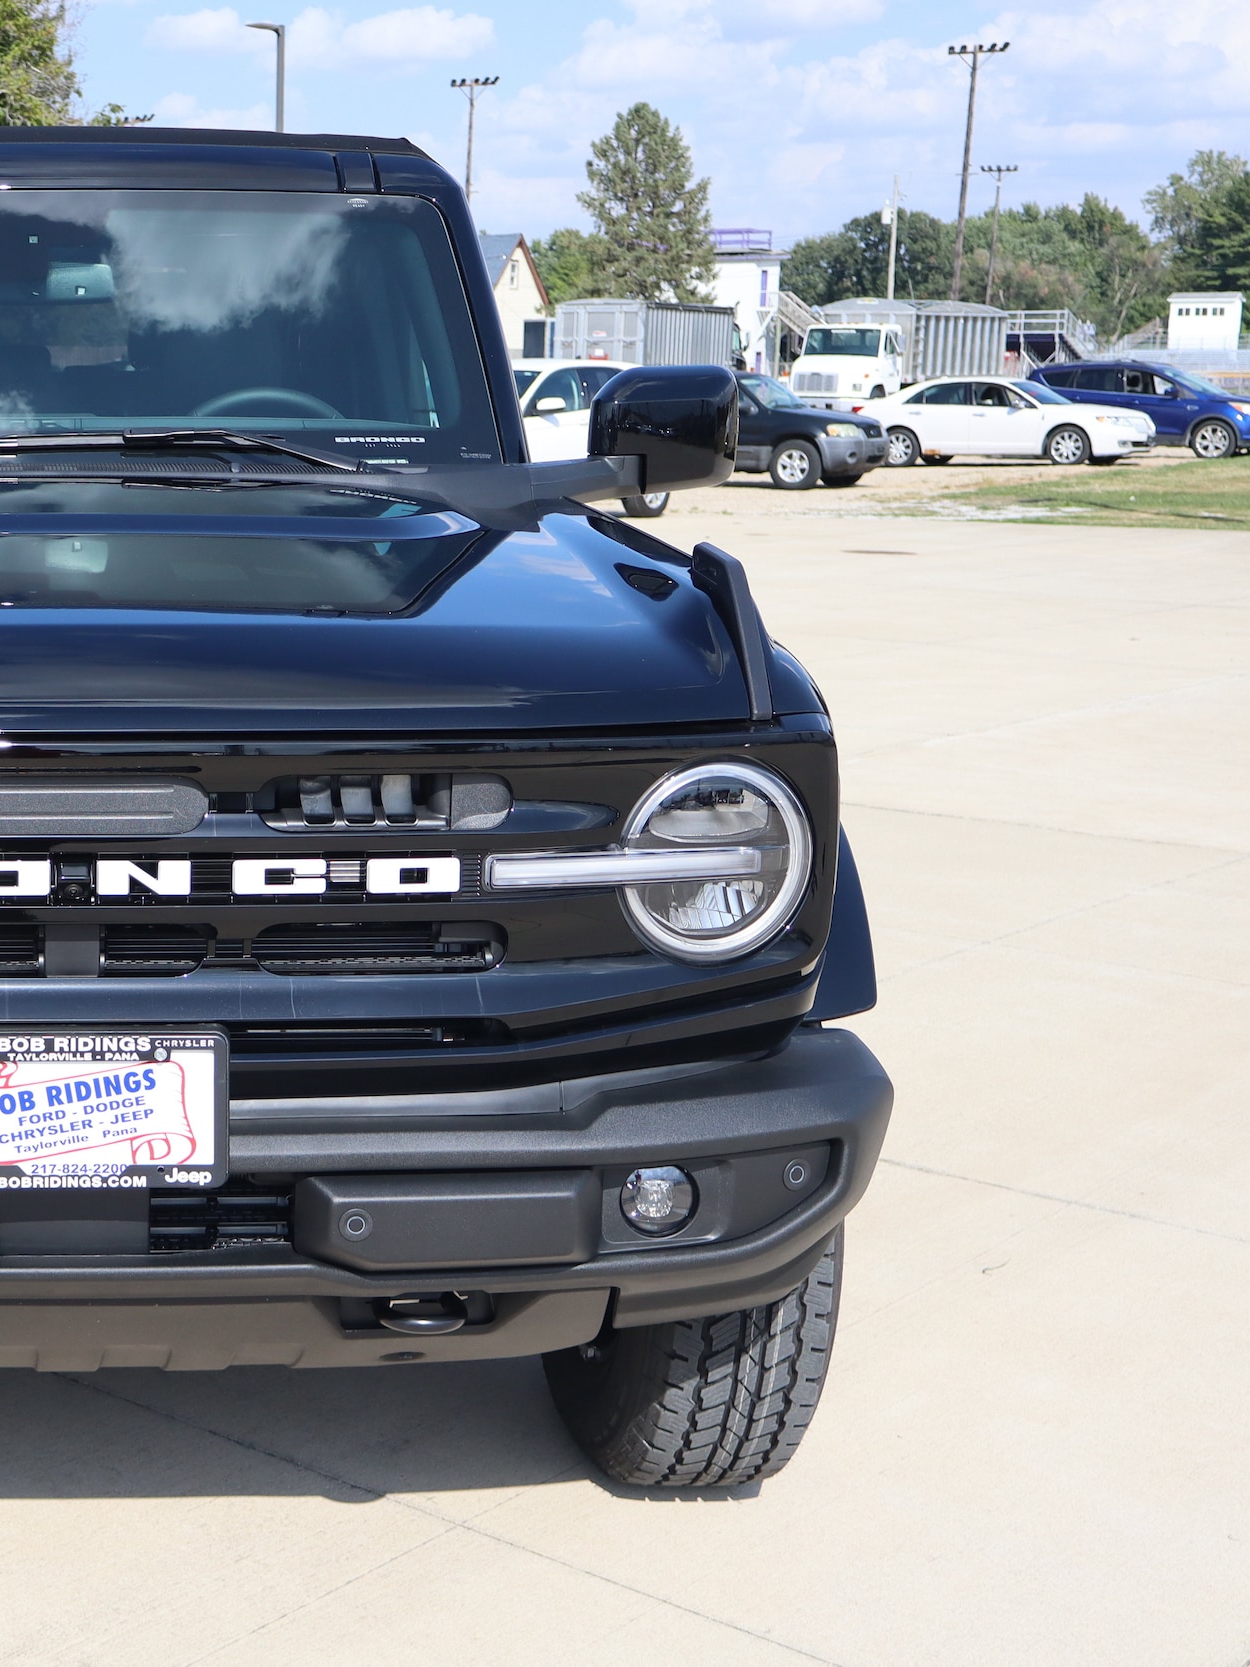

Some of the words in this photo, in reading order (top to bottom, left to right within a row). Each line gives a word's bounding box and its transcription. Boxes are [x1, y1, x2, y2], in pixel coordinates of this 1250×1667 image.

[53, 1036, 152, 1052] RIDINGS
[154, 1039, 215, 1048] CHRYSLER
[7, 1052, 93, 1061] TAYLORVILLE
[104, 1052, 140, 1061] PANA
[45, 1068, 156, 1107] RIDINGS
[18, 1109, 66, 1127] FORD
[83, 1095, 146, 1115] DODGE
[110, 1108, 155, 1125] JEEP
[13, 1134, 90, 1154] Taylorville
[102, 1126, 138, 1138] Pana
[31, 1163, 128, 1175] 217-824-2200
[164, 1167, 213, 1186] Jeep
